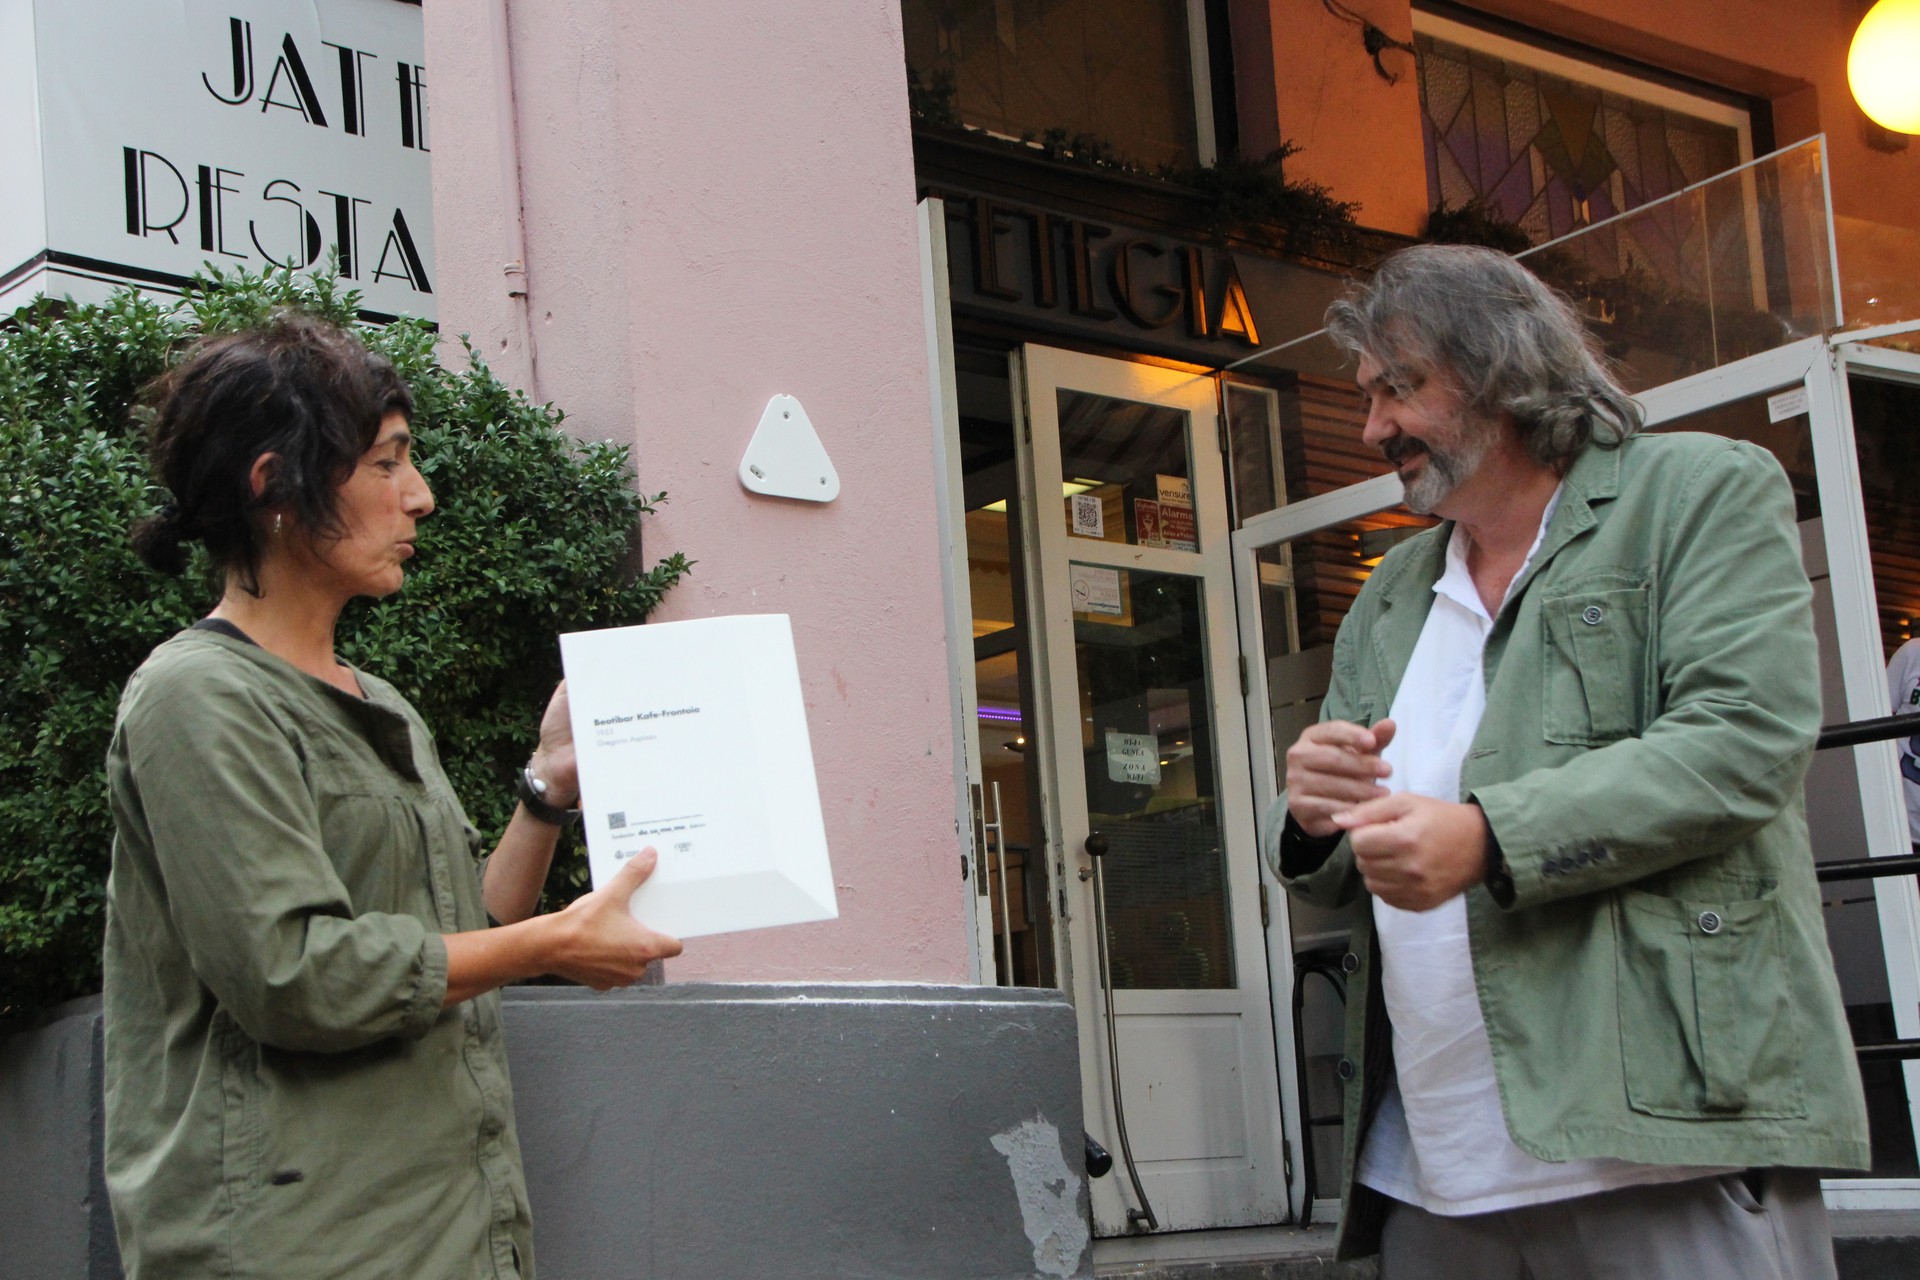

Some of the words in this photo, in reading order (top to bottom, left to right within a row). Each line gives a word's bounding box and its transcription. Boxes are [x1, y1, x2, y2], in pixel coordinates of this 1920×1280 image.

[123, 146, 433, 293] RESTA
[1160, 489, 1190, 500] verisure
[1162, 507, 1194, 520] Alarma
[637, 706, 701, 721] Kafe-Frontoia
